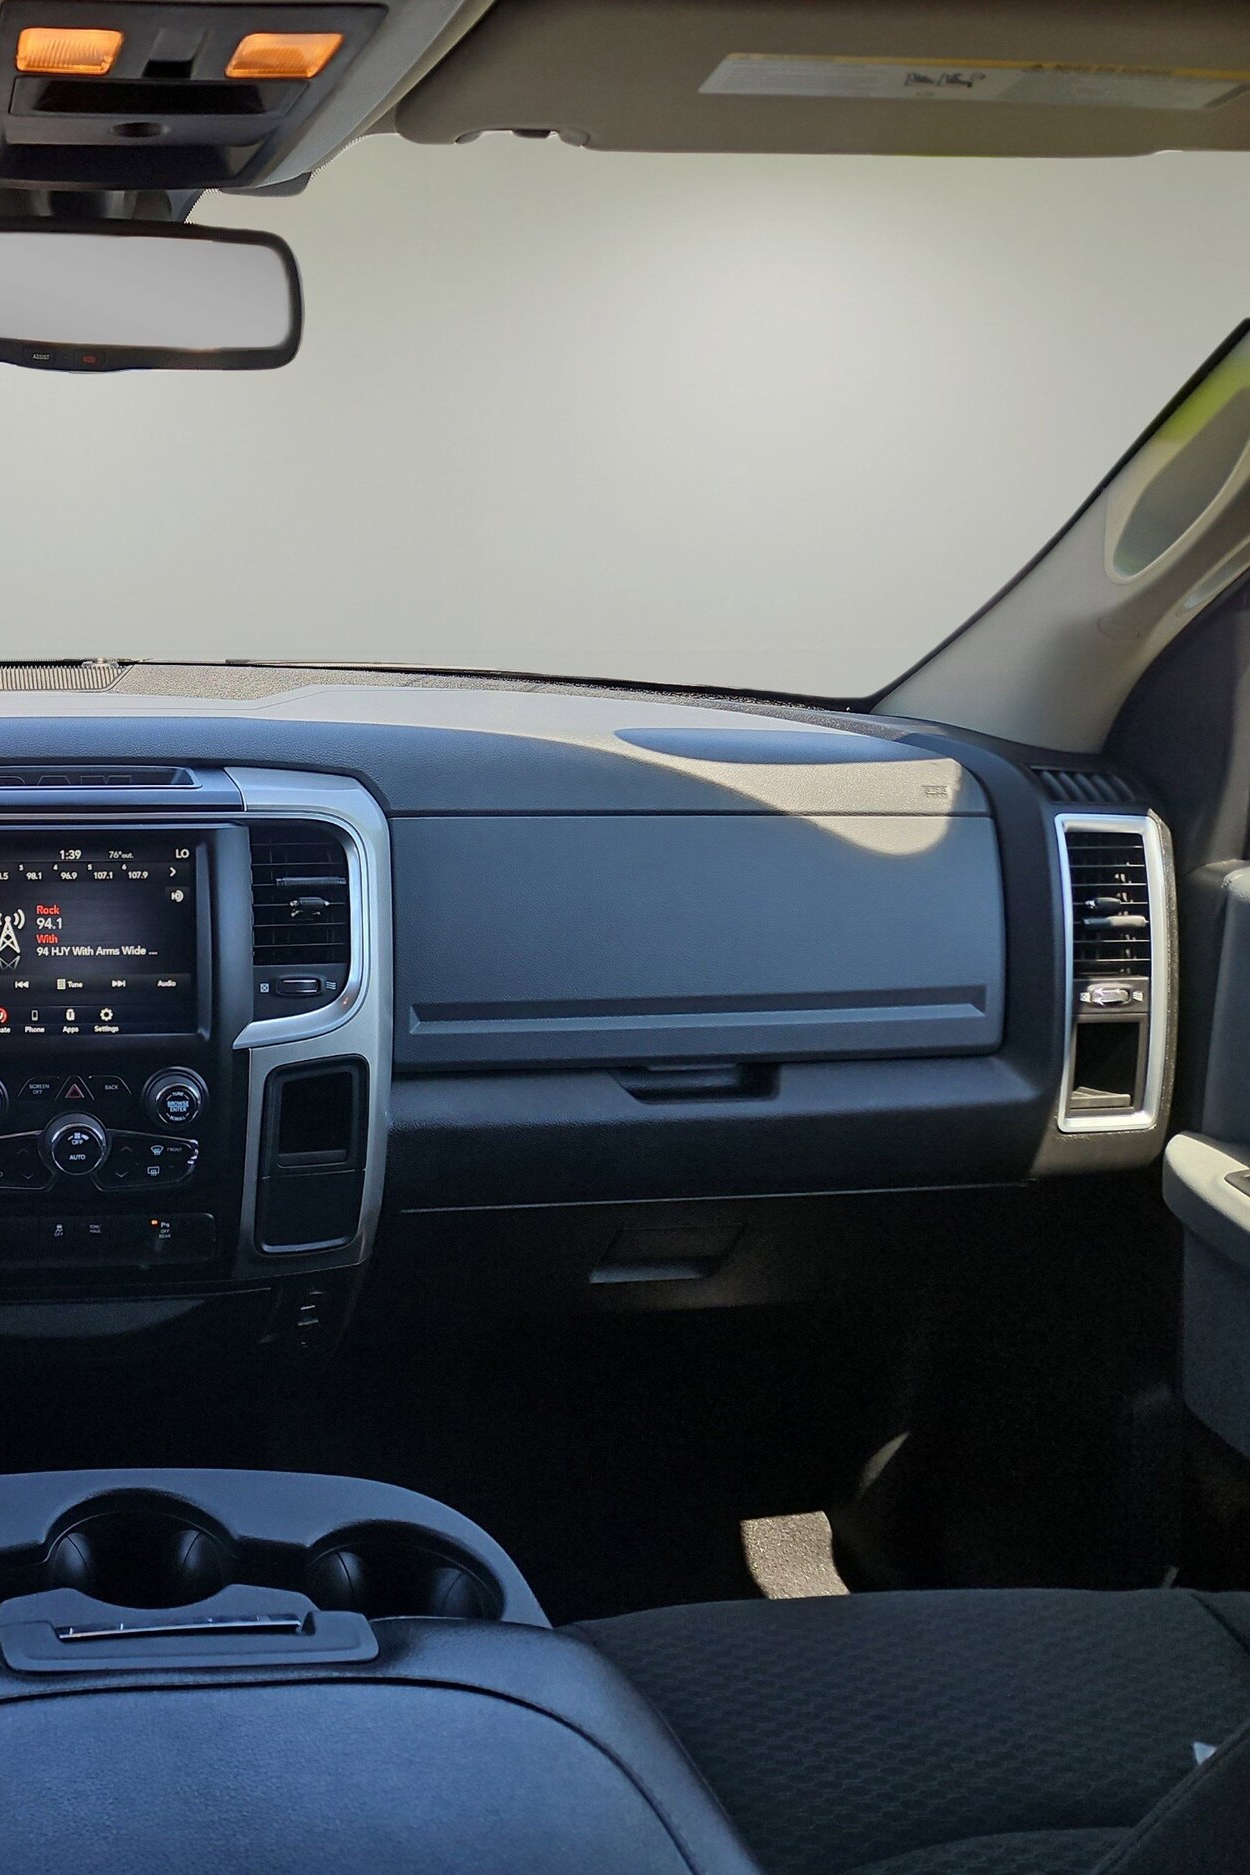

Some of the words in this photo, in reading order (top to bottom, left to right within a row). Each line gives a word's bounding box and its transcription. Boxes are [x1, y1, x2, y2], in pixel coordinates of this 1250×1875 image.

[59, 850, 82, 860] 1:39
[175, 848, 190, 859] LO
[26, 872, 43, 880] 98.1
[60, 872, 78, 880] 96.9
[93, 871, 113, 879] 107.1
[127, 871, 149, 879] 107.9
[36, 905, 60, 915] Rock
[36, 917, 63, 930] 94.1
[36, 934, 59, 944] With
[36, 947, 49, 956] 94
[51, 947, 71, 956] HJY
[72, 946, 94, 956] With
[95, 946, 120, 955] Arms
[121, 945, 147, 955] Wide
[62, 1026, 80, 1034] Apps
[93, 1025, 119, 1034] Settings
